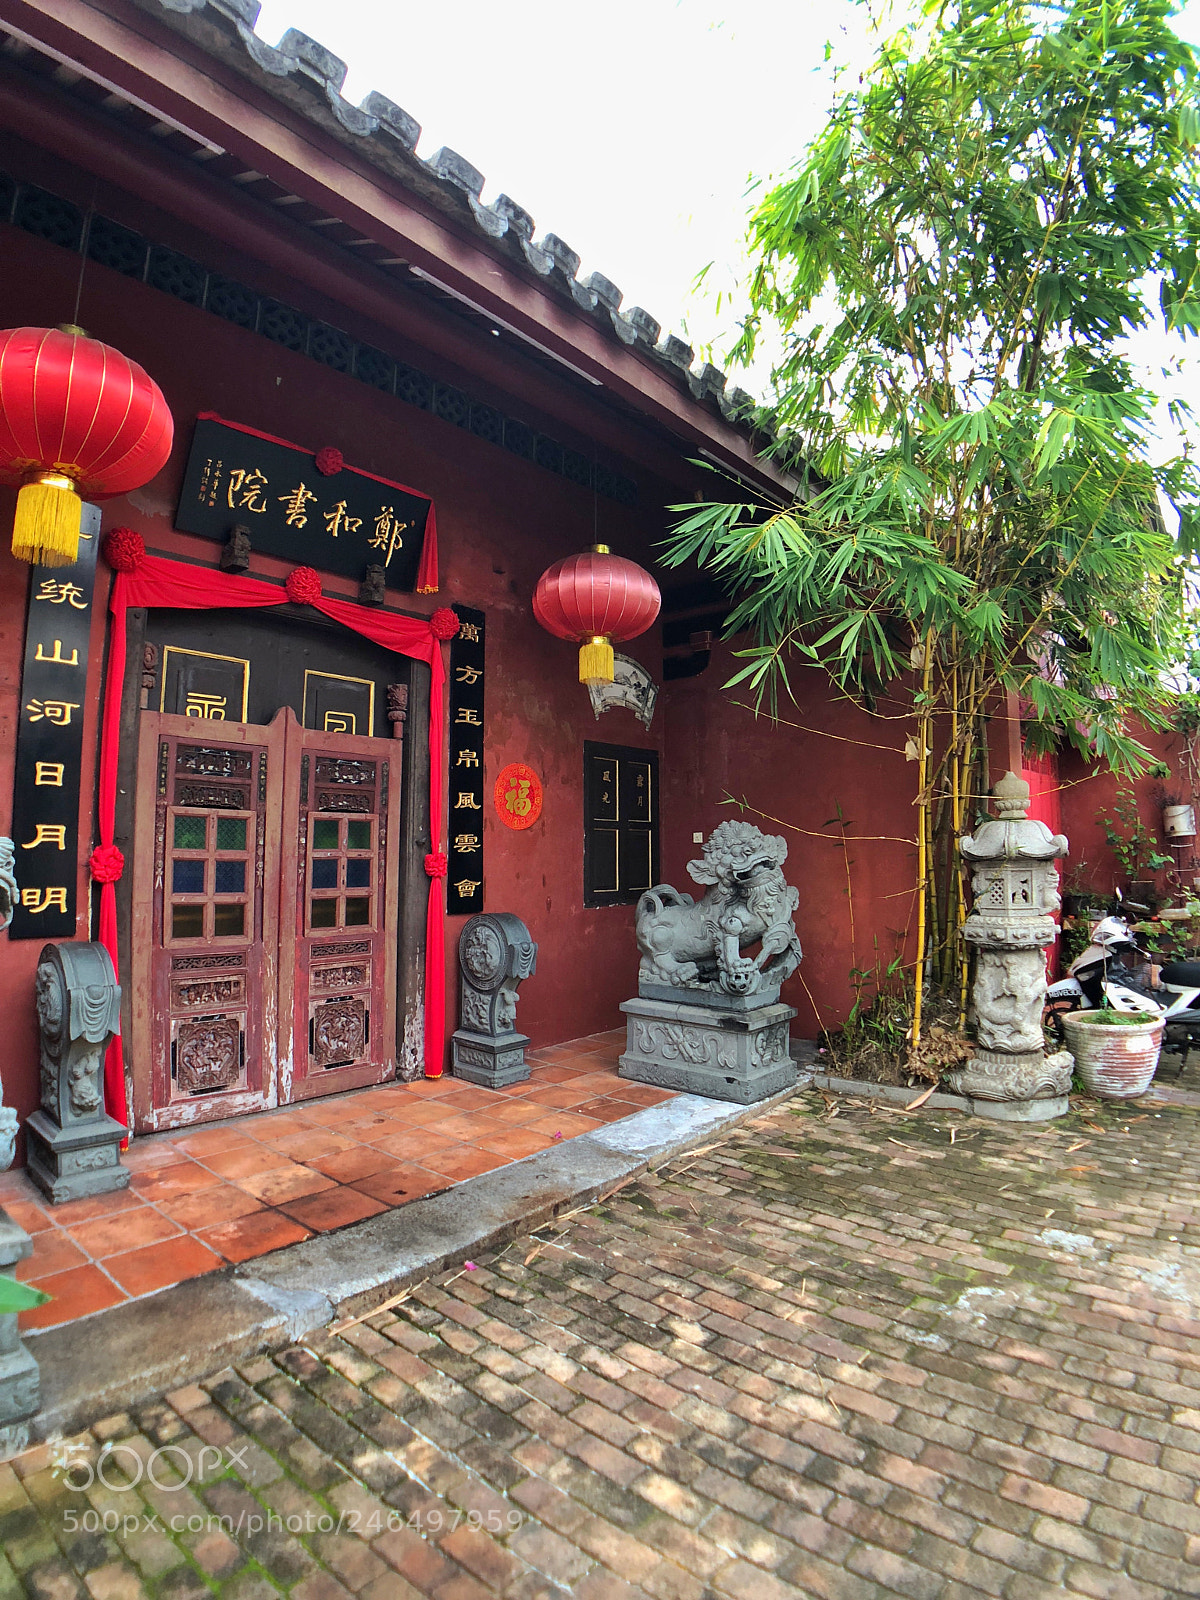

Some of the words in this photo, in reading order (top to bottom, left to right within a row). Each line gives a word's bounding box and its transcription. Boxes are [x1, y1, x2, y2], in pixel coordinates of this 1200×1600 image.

[227, 468, 407, 568] 鄭和書院
[20, 532, 93, 914] 统山河日月明
[453, 622, 483, 898] 萬方玉帛風雲會
[505, 777, 532, 816] 福
